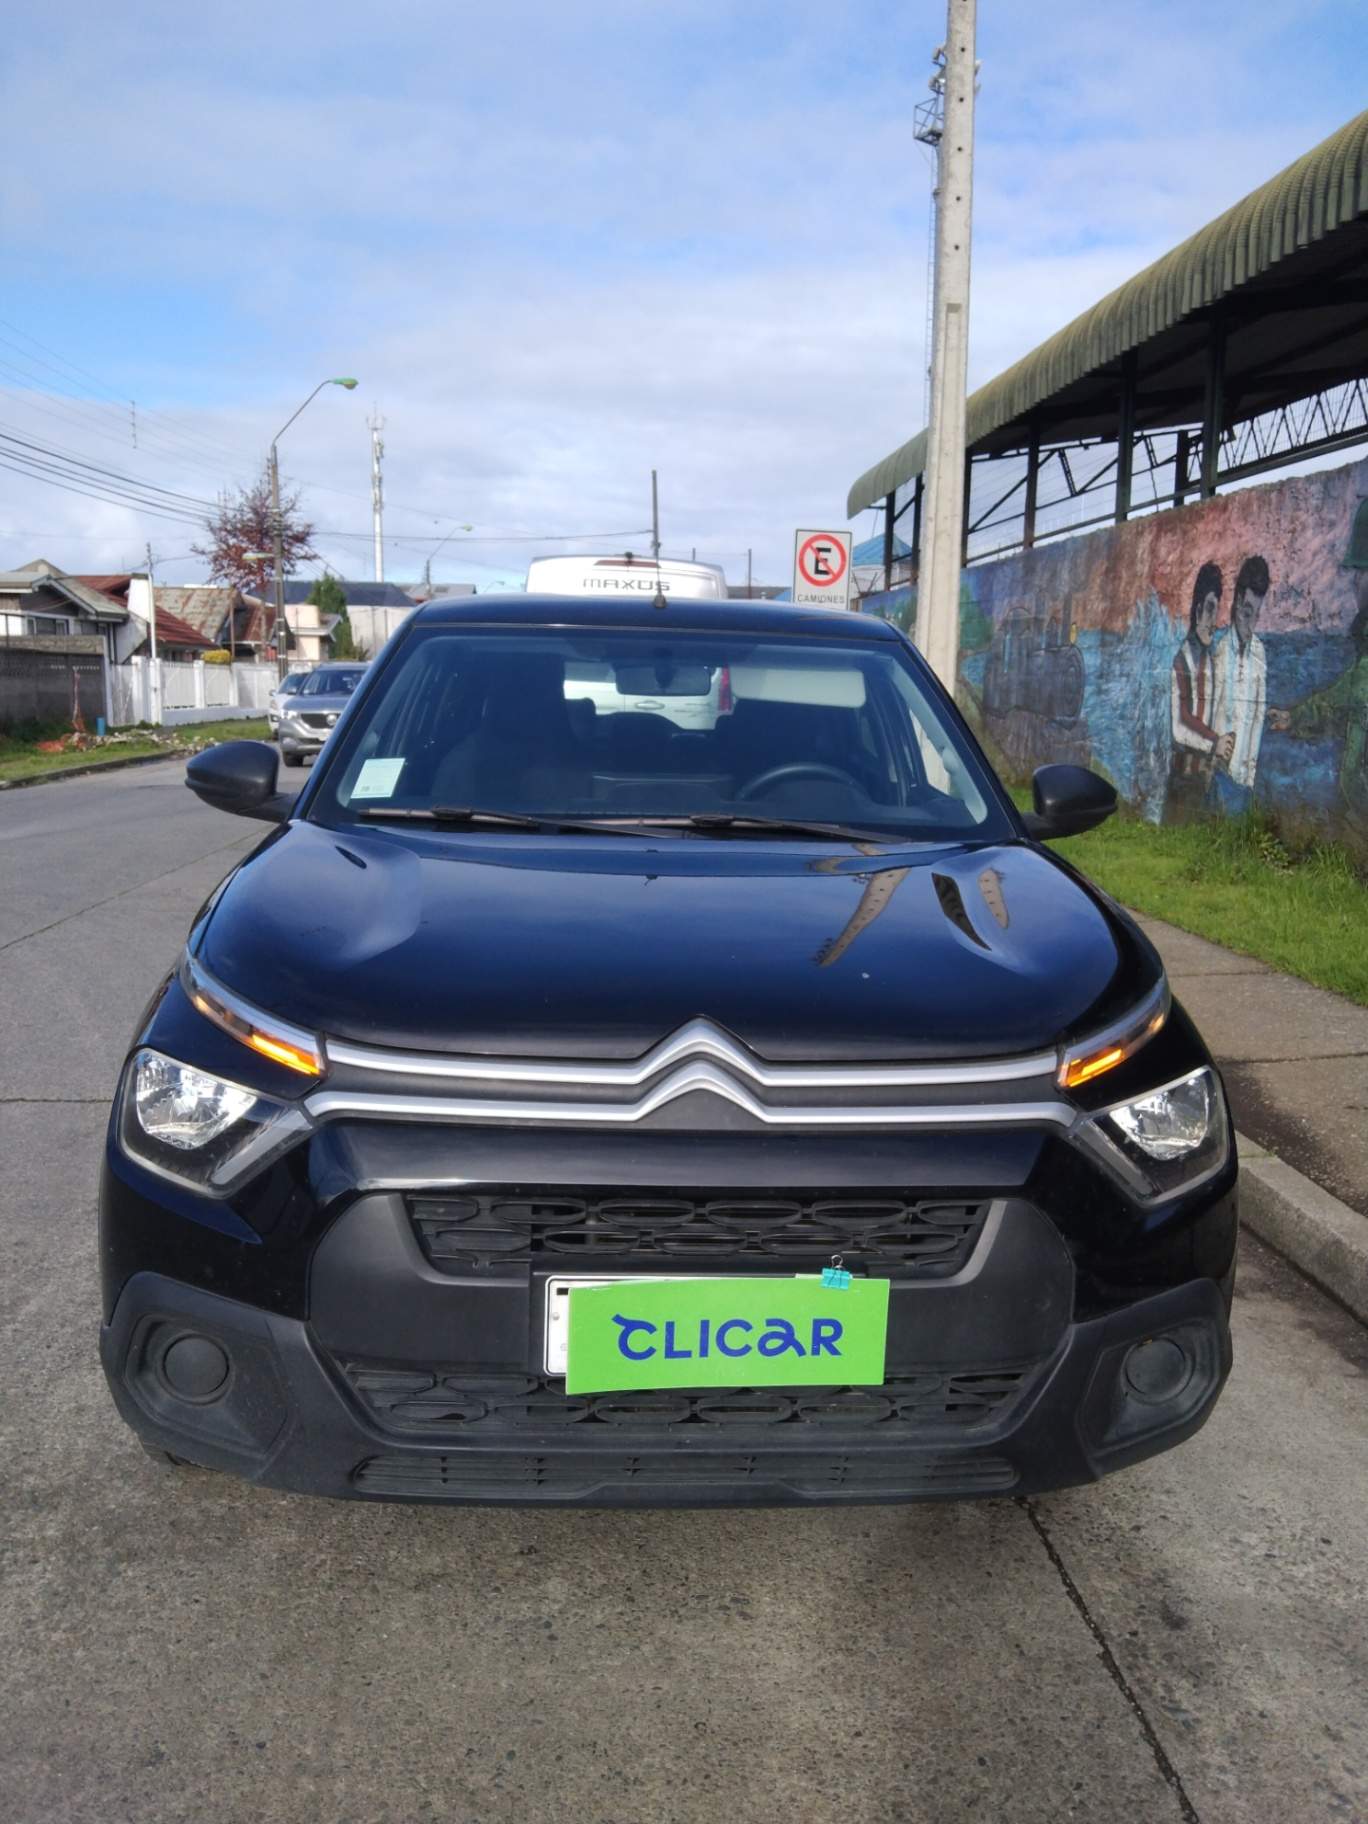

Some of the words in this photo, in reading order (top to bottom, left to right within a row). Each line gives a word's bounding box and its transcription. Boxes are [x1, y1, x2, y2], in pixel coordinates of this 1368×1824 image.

[814, 547, 832, 575] E
[583, 578, 670, 591] MAXUS
[797, 593, 846, 604] CAMIONES
